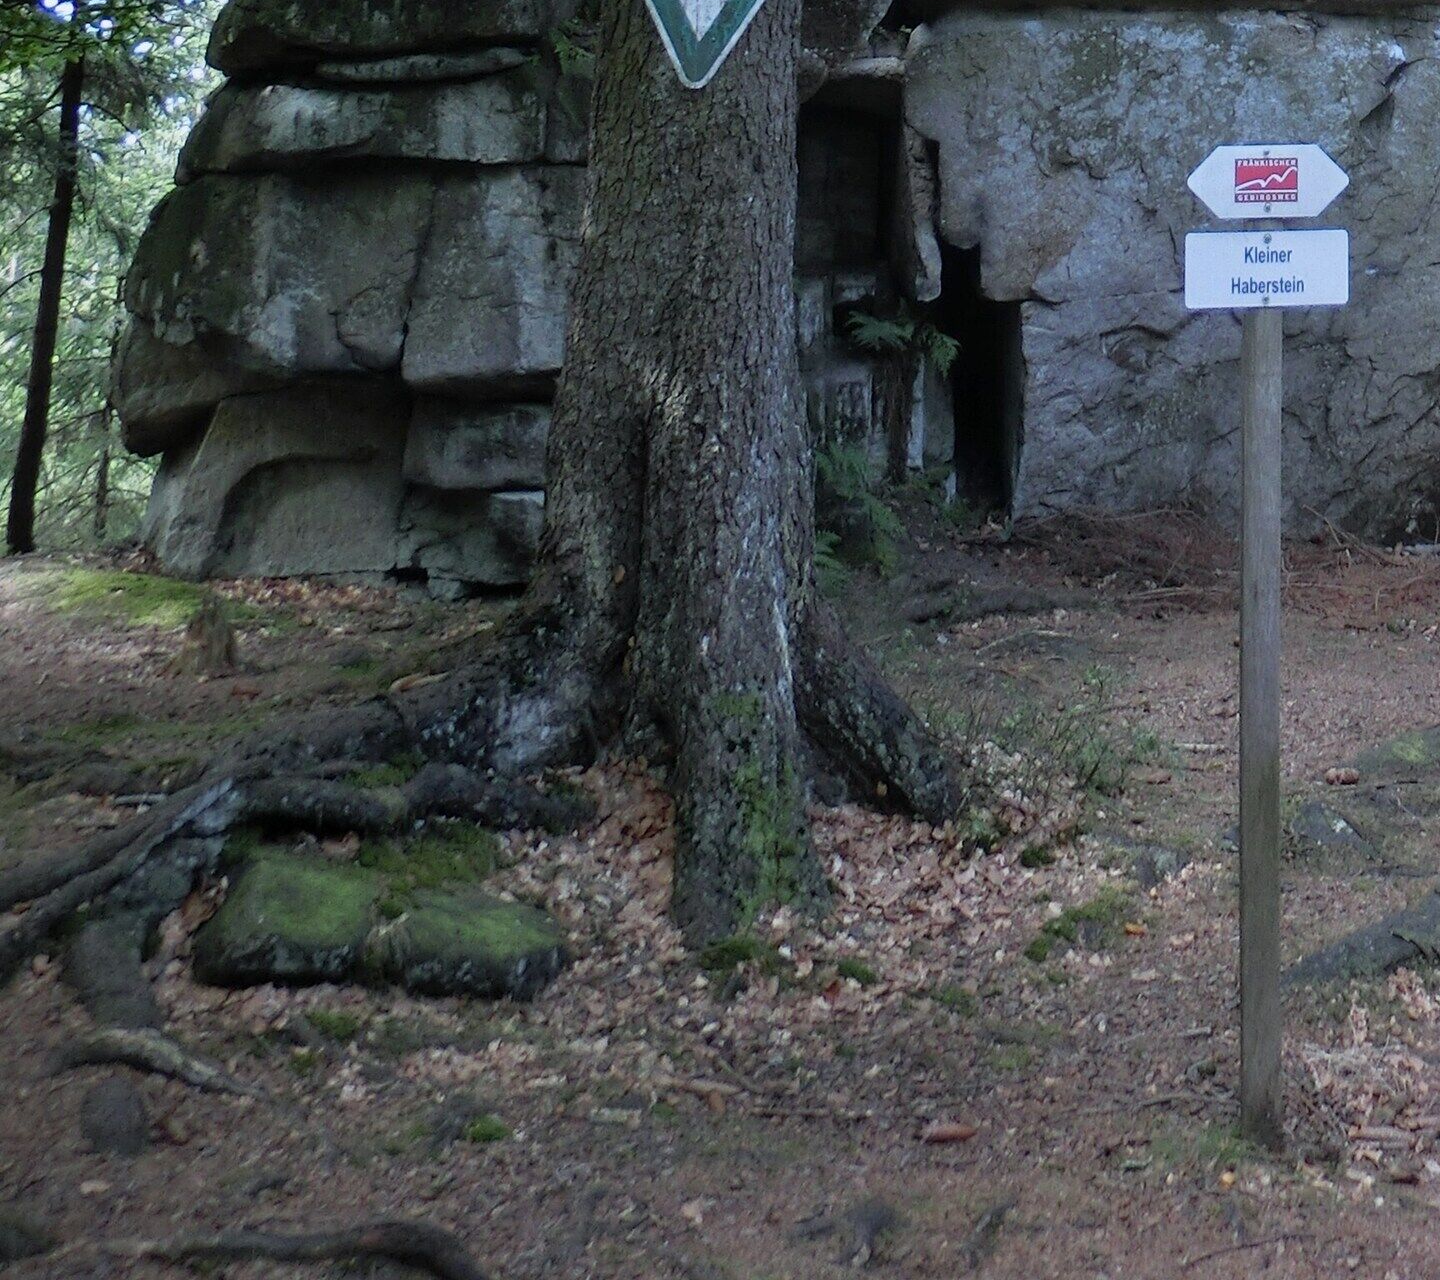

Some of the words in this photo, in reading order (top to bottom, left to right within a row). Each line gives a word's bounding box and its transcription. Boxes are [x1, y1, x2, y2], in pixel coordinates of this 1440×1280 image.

[1237, 158, 1296, 167] FRÄNKISCHER
[1244, 246, 1292, 264] Kleiner
[1231, 276, 1304, 294] Haberstein
